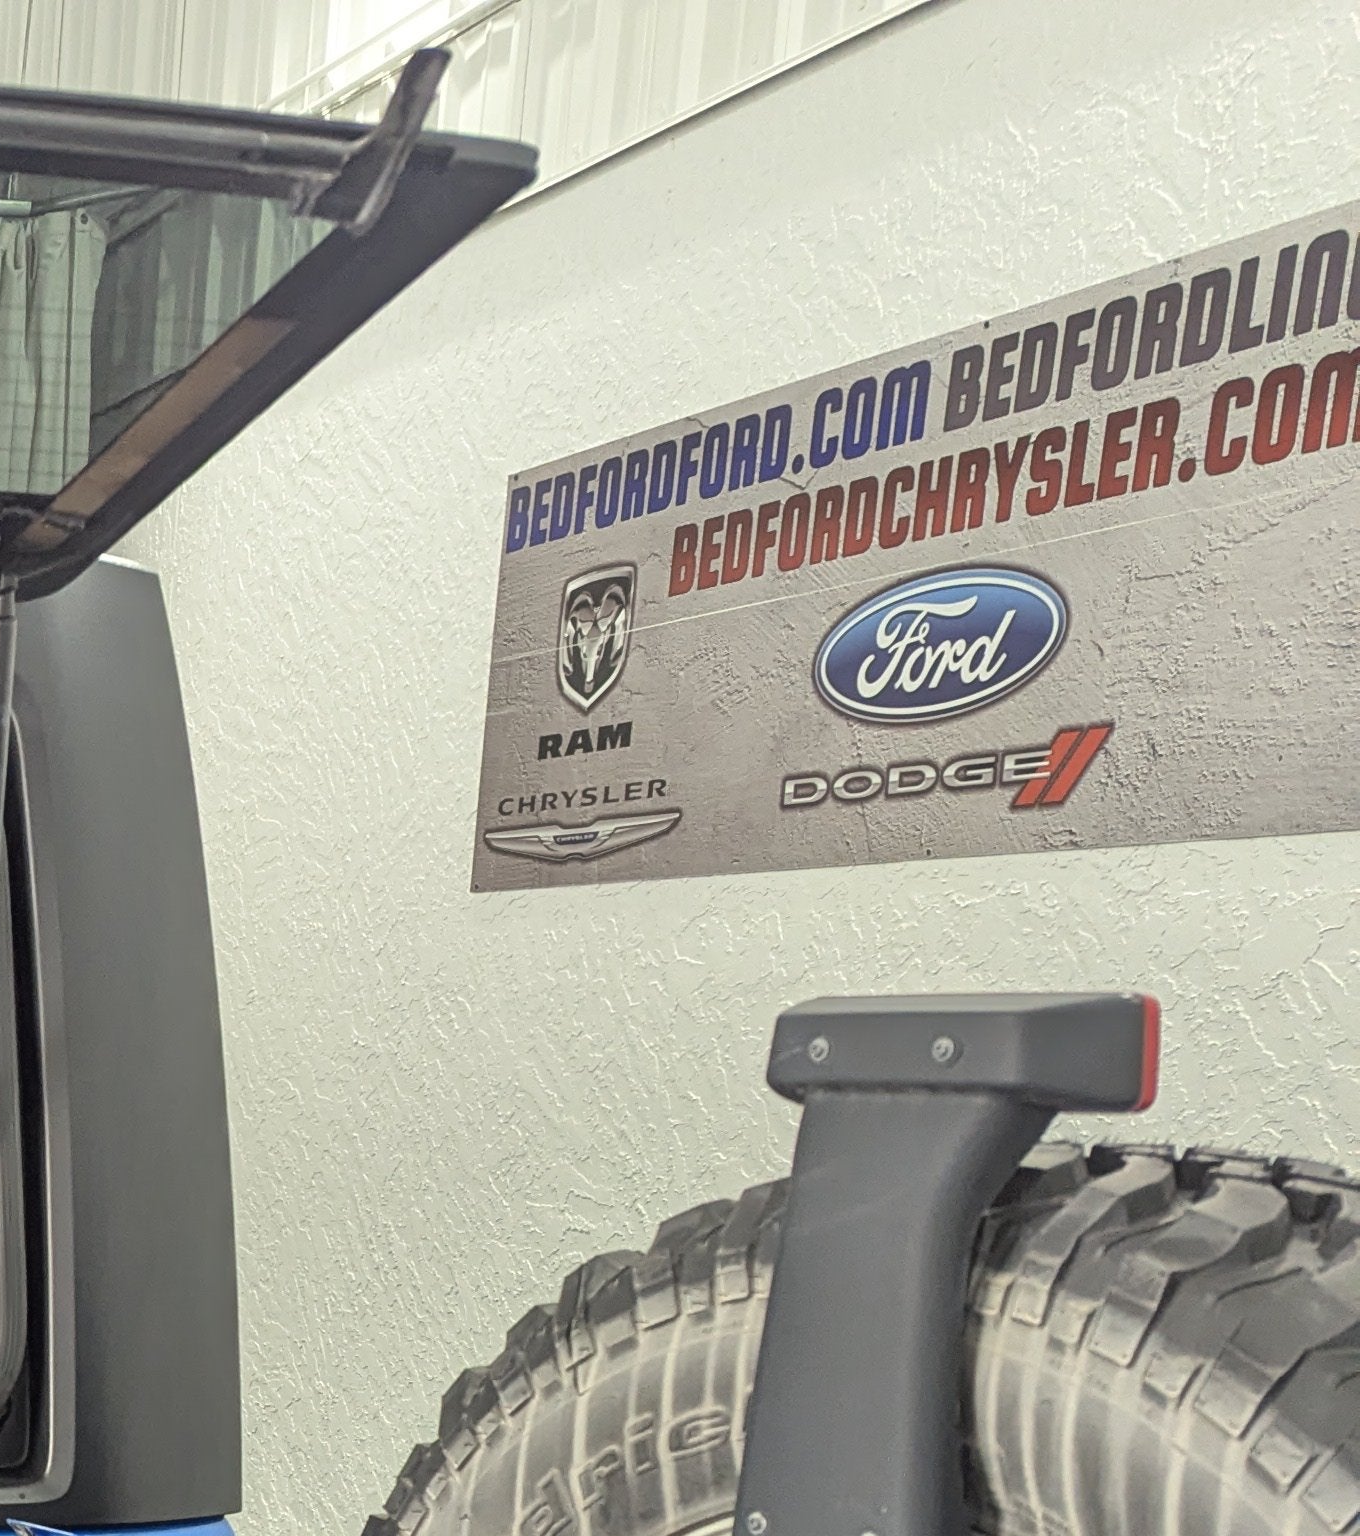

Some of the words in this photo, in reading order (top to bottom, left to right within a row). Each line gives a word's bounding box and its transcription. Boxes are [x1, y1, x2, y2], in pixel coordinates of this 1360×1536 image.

[506, 360, 932, 554] BEDFORDFORD.COM
[943, 229, 1360, 432] BEDFORDLIN
[668, 347, 1360, 597] BEDFORDCHRYSLER.COM
[857, 595, 1016, 699] Ford
[537, 721, 633, 760] RAM
[782, 749, 1053, 807] DODGE
[497, 778, 668, 816] CHRYSLER
